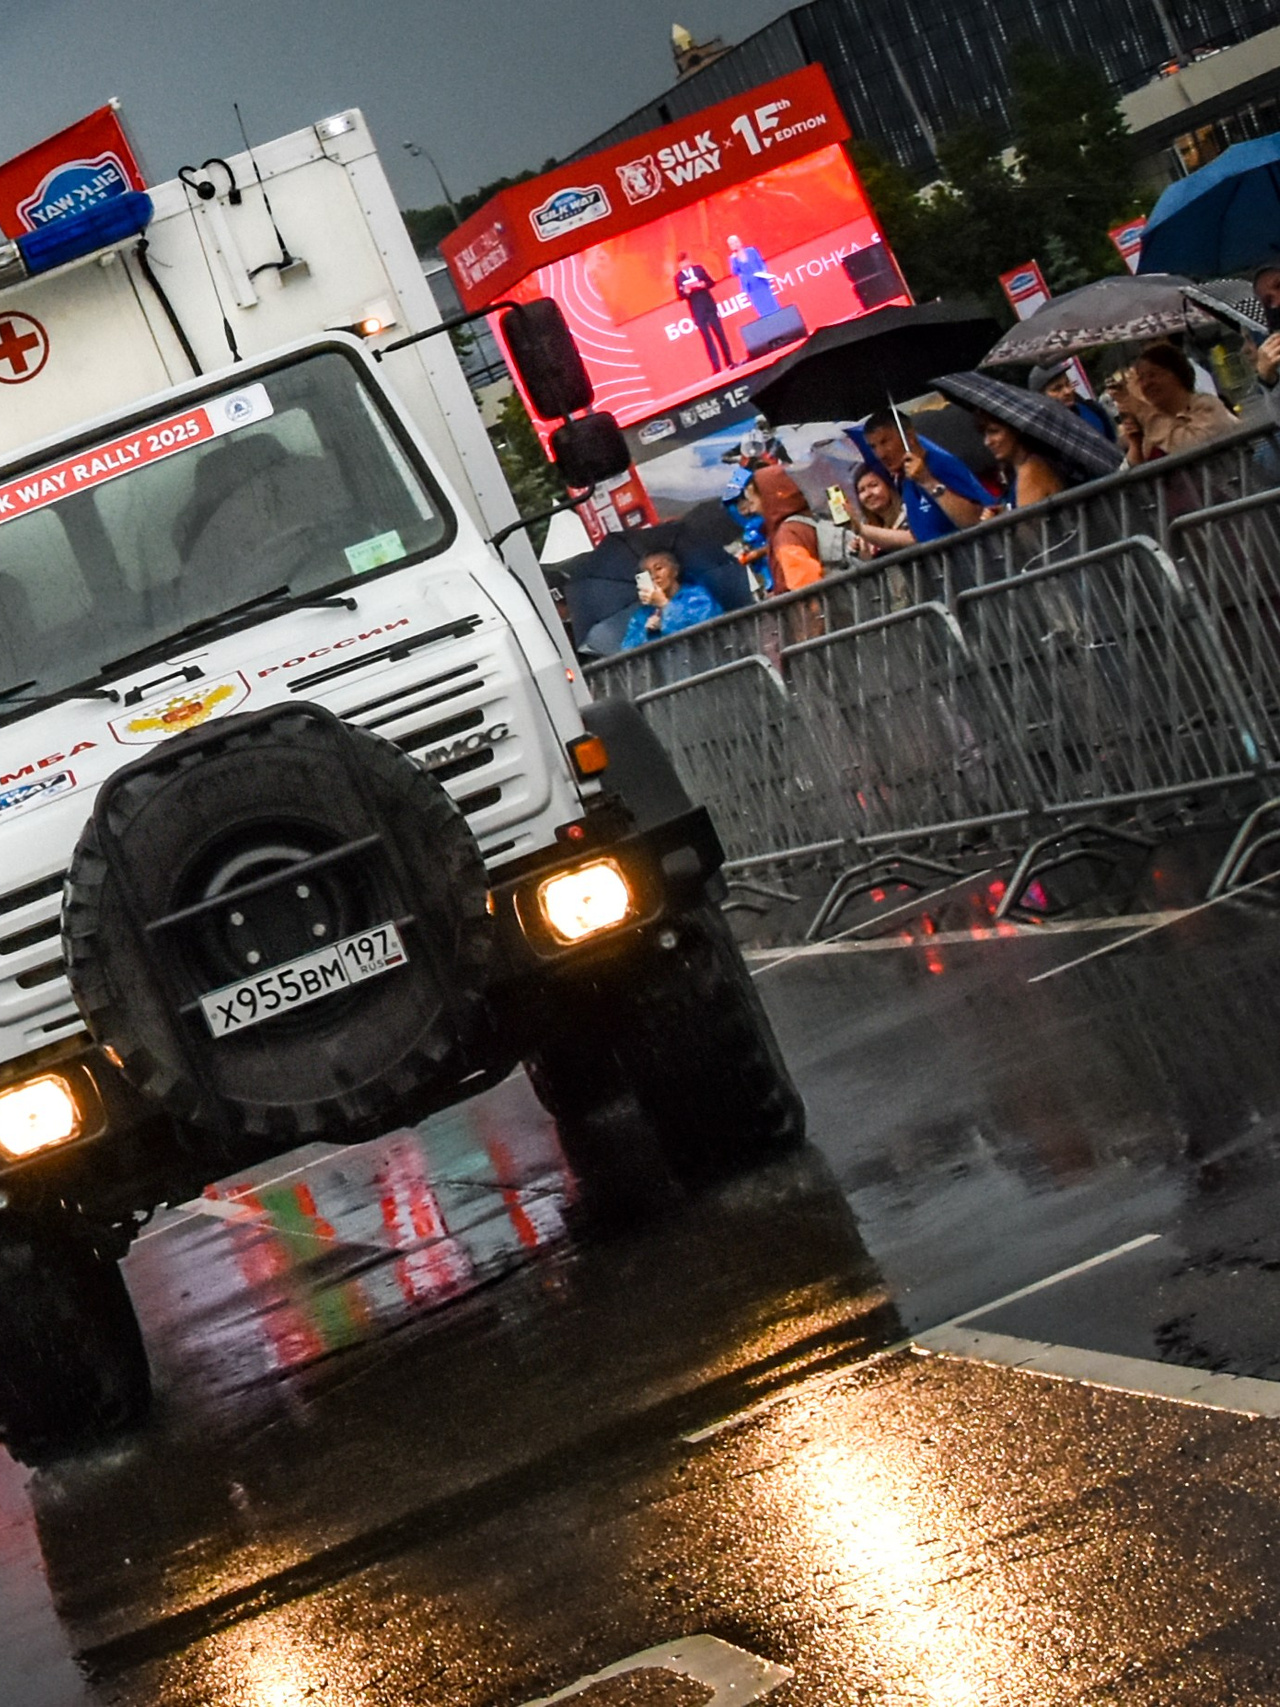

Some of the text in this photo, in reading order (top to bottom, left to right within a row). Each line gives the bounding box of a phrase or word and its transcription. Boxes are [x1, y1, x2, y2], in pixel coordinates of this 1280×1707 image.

[656, 130, 718, 170] SILK
[665, 113, 827, 187] WAY EDITION
[664, 292, 752, 341] БОШЕ
[16, 470, 68, 504] WAY
[72, 440, 142, 482] RALLY
[146, 419, 201, 452] 2025
[258, 618, 409, 678] РОССИИ
[344, 929, 388, 966] 197
[359, 959, 385, 975] RUS
